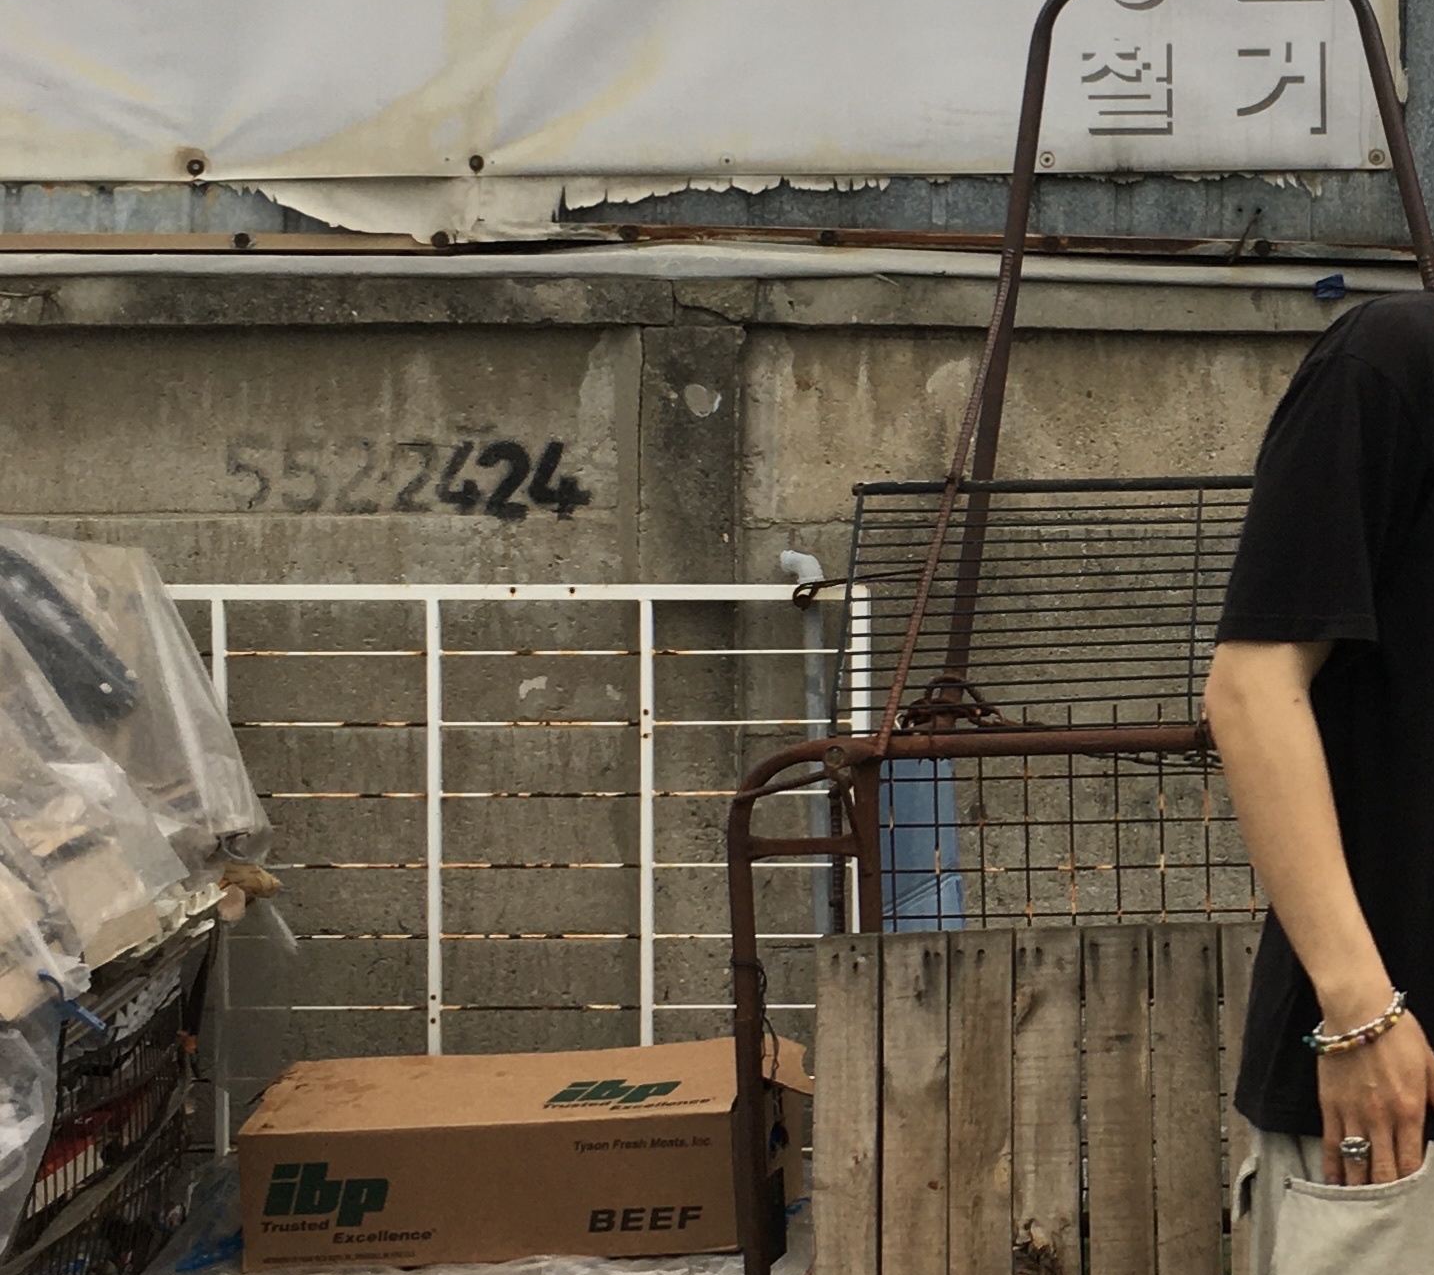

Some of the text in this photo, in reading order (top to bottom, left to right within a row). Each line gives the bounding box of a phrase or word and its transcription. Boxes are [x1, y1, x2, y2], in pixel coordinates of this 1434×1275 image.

[546, 1078, 682, 1104] ibp
[542, 1097, 711, 1111] Trusted Excellence
[574, 1140, 610, 1154] Tyson
[612, 1138, 647, 1150] Fresh
[649, 1136, 689, 1150] Meats,
[262, 1161, 390, 1227] ibp
[260, 1219, 330, 1233] Trusted
[588, 1205, 704, 1233] BEEF
[332, 1229, 433, 1244] Excellence
